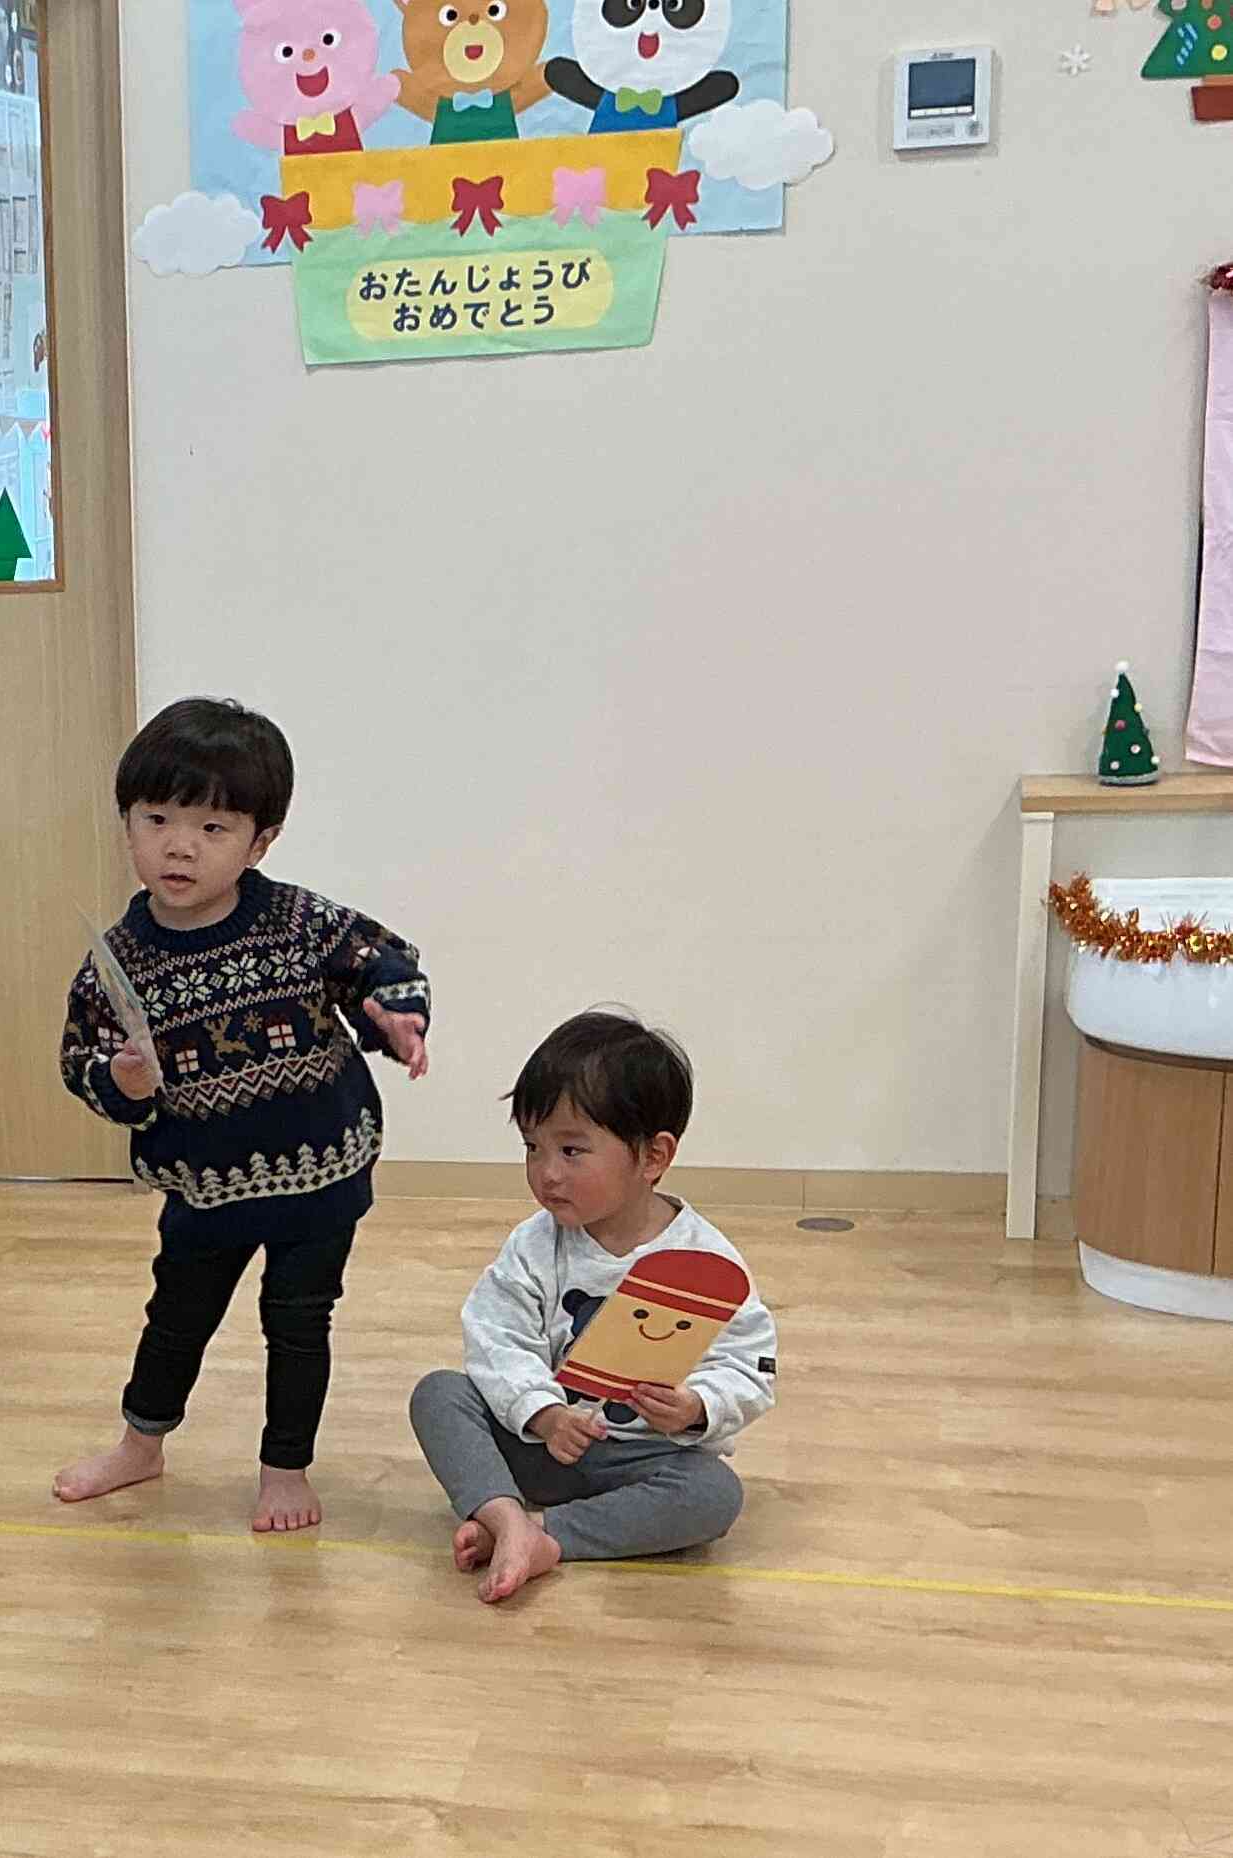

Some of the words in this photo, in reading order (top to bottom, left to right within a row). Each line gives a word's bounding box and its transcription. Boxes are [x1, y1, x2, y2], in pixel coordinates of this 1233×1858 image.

[359, 257, 591, 300] おたんじょうび
[393, 295, 555, 333] おめでとう
